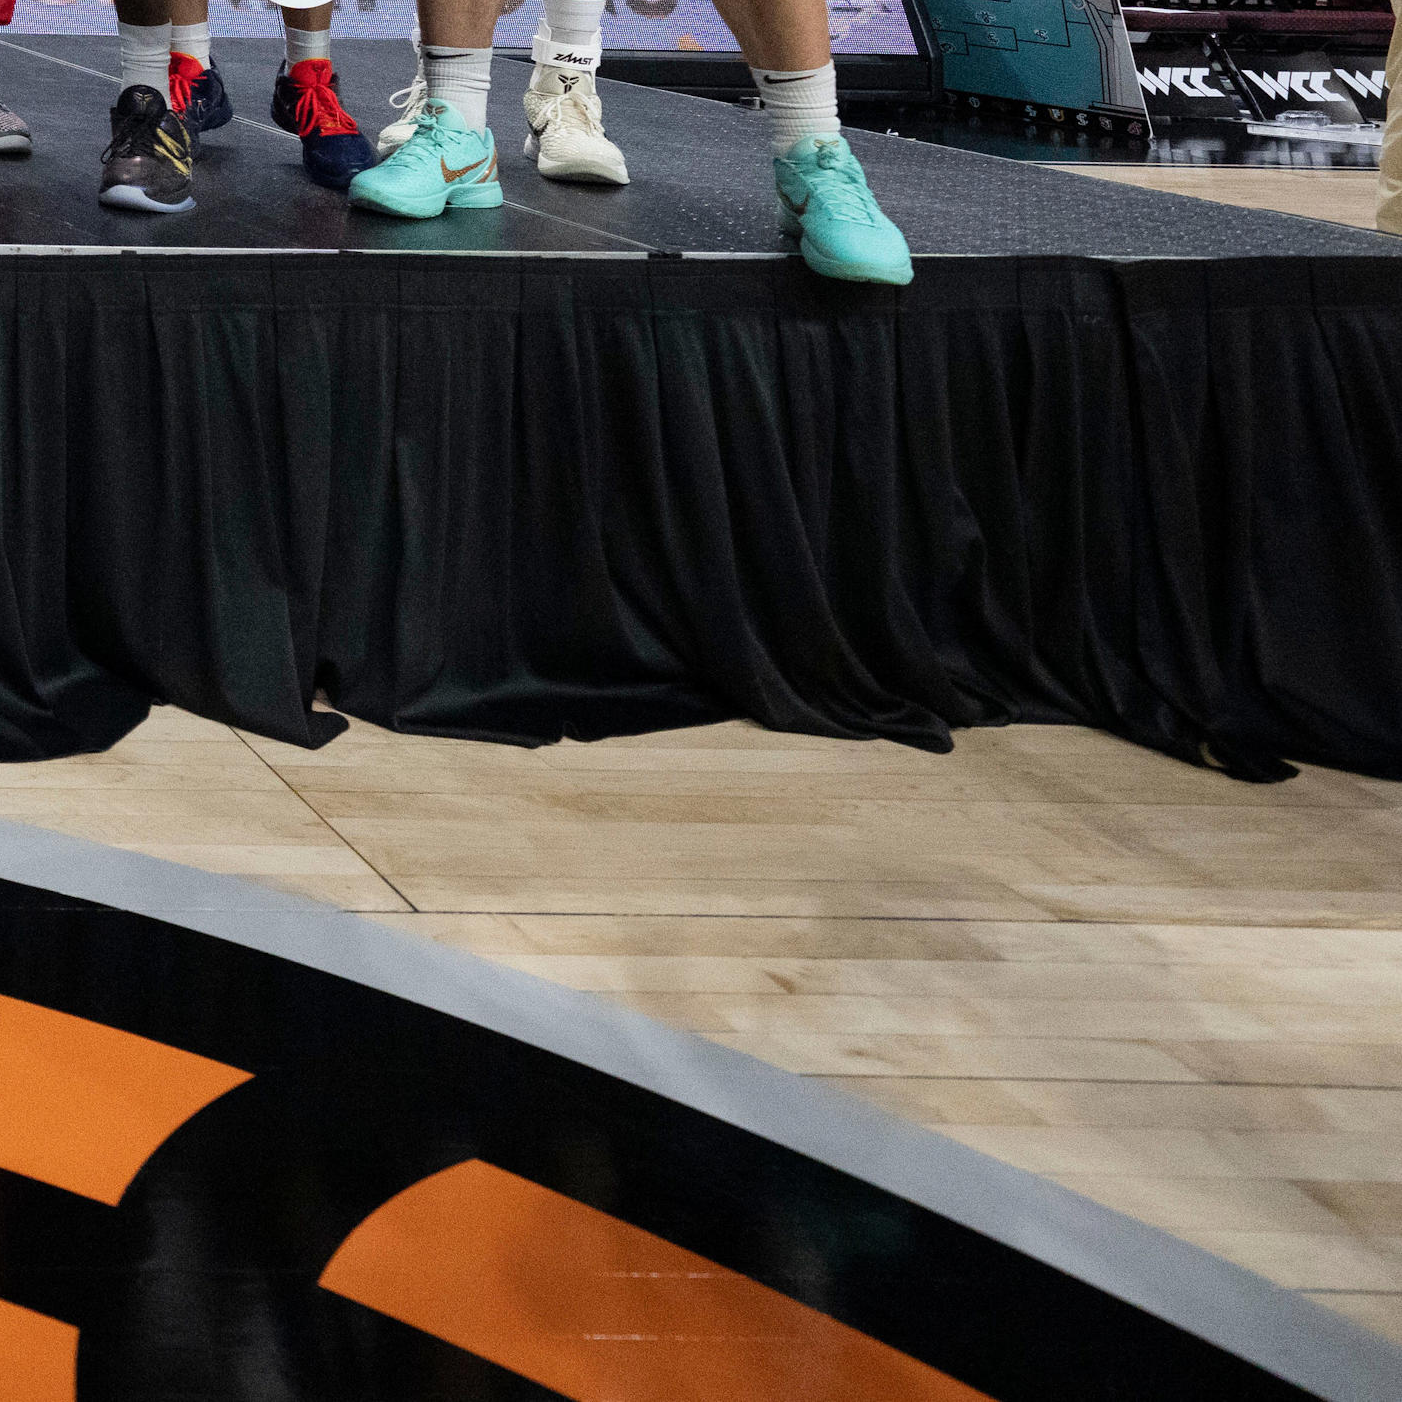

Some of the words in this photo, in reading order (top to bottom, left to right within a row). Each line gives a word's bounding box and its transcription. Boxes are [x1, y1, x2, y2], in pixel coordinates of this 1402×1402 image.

[553, 52, 594, 66] ZAMST
[1136, 66, 1226, 98] WCC
[1241, 69, 1347, 102] WCC
